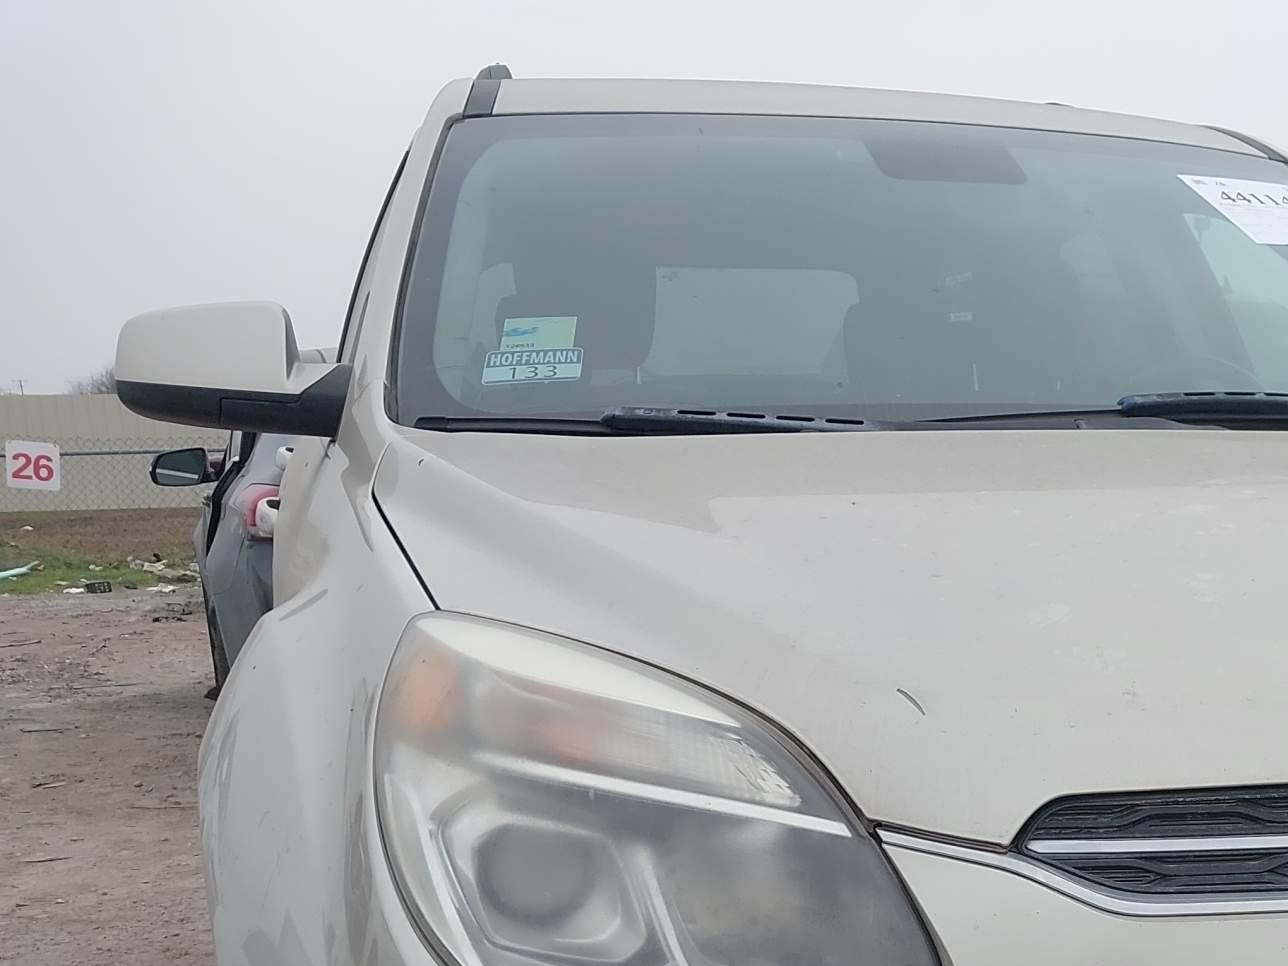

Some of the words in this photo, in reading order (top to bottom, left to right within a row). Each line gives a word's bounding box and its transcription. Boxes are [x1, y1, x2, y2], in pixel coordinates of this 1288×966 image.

[489, 350, 578, 366] HOFFMANN
[509, 365, 558, 379] 133
[12, 452, 54, 482] 26
